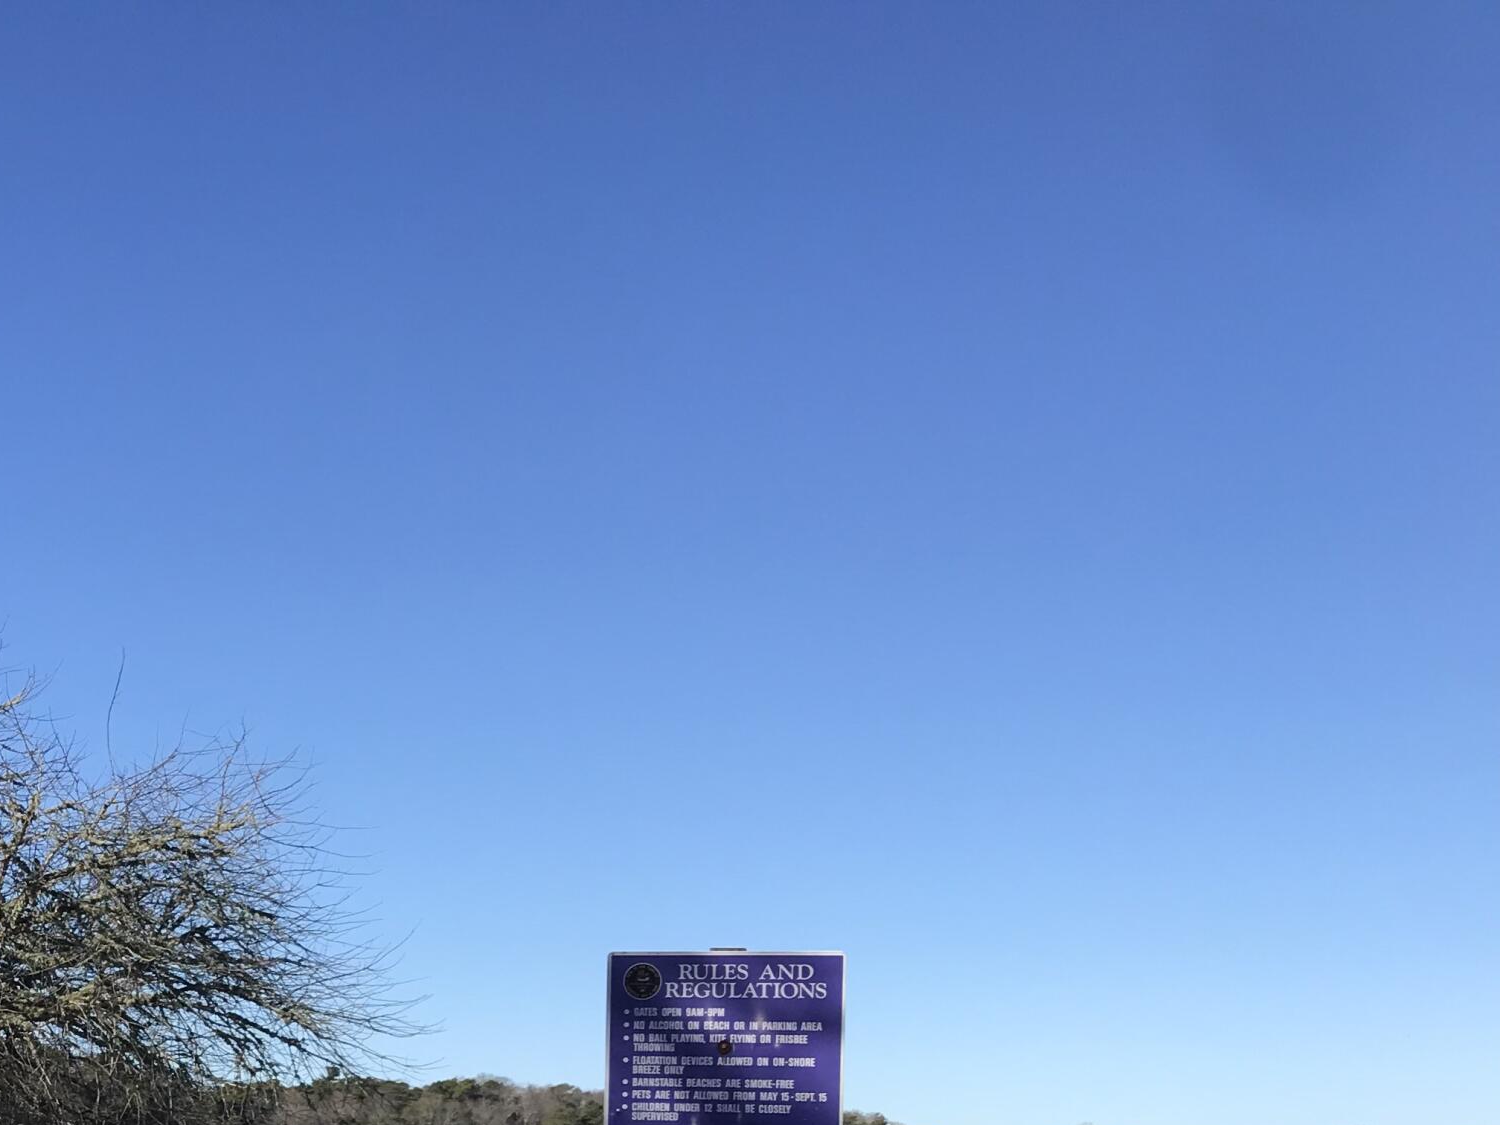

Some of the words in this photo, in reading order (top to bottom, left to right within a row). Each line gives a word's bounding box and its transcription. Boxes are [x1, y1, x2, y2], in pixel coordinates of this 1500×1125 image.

[678, 964, 748, 980] RULES
[759, 964, 814, 980] AND
[665, 982, 827, 999] REGULATIONS
[634, 1008, 657, 1016] GATES
[662, 1008, 681, 1016] OPEN
[633, 1021, 645, 1029] NO
[649, 1021, 684, 1029] ALCOHOL
[688, 1021, 699, 1029] ON
[704, 1021, 730, 1030] BEACH
[734, 1022, 745, 1030] OR
[749, 1022, 758, 1030] IN
[762, 1022, 797, 1030] PARKING
[801, 1022, 822, 1031] AREA
[633, 1034, 645, 1042] NO
[649, 1034, 667, 1042] BALL
[671, 1034, 706, 1043] PLAYING,
[709, 1034, 726, 1043] KITE
[730, 1034, 756, 1043] FLYING
[760, 1035, 771, 1043] OR
[776, 1035, 808, 1044] FRISBEE
[633, 1043, 675, 1051] THROWING
[633, 1056, 677, 1064] FLOATATION
[681, 1057, 713, 1065] DEVICES
[717, 1057, 753, 1066] ALLOWED
[757, 1058, 768, 1066] ON
[773, 1058, 815, 1067] ON-SHORE
[632, 1066, 660, 1074] BREEZE
[664, 1066, 684, 1074] ONLY
[632, 1078, 683, 1087] BARNSTABLE
[686, 1079, 721, 1087] BEACHES
[725, 1079, 741, 1088] ARE
[745, 1079, 794, 1089] SMOKE-FREE
[632, 1090, 651, 1099] PETS
[655, 1090, 670, 1099] ARE
[674, 1091, 690, 1099] NOT
[693, 1091, 729, 1100] ALLOWED
[733, 1092, 755, 1100] FROM
[760, 1092, 778, 1101] MAY
[819, 1093, 827, 1102] 15
[632, 1103, 670, 1111] CHILDREN
[674, 1103, 700, 1112] UNDER
[705, 1104, 712, 1112] 12
[717, 1104, 740, 1113] SHALL
[745, 1104, 755, 1113] BE
[759, 1105, 792, 1113] CLOSELY
[631, 1112, 678, 1120] SUPERVISED
